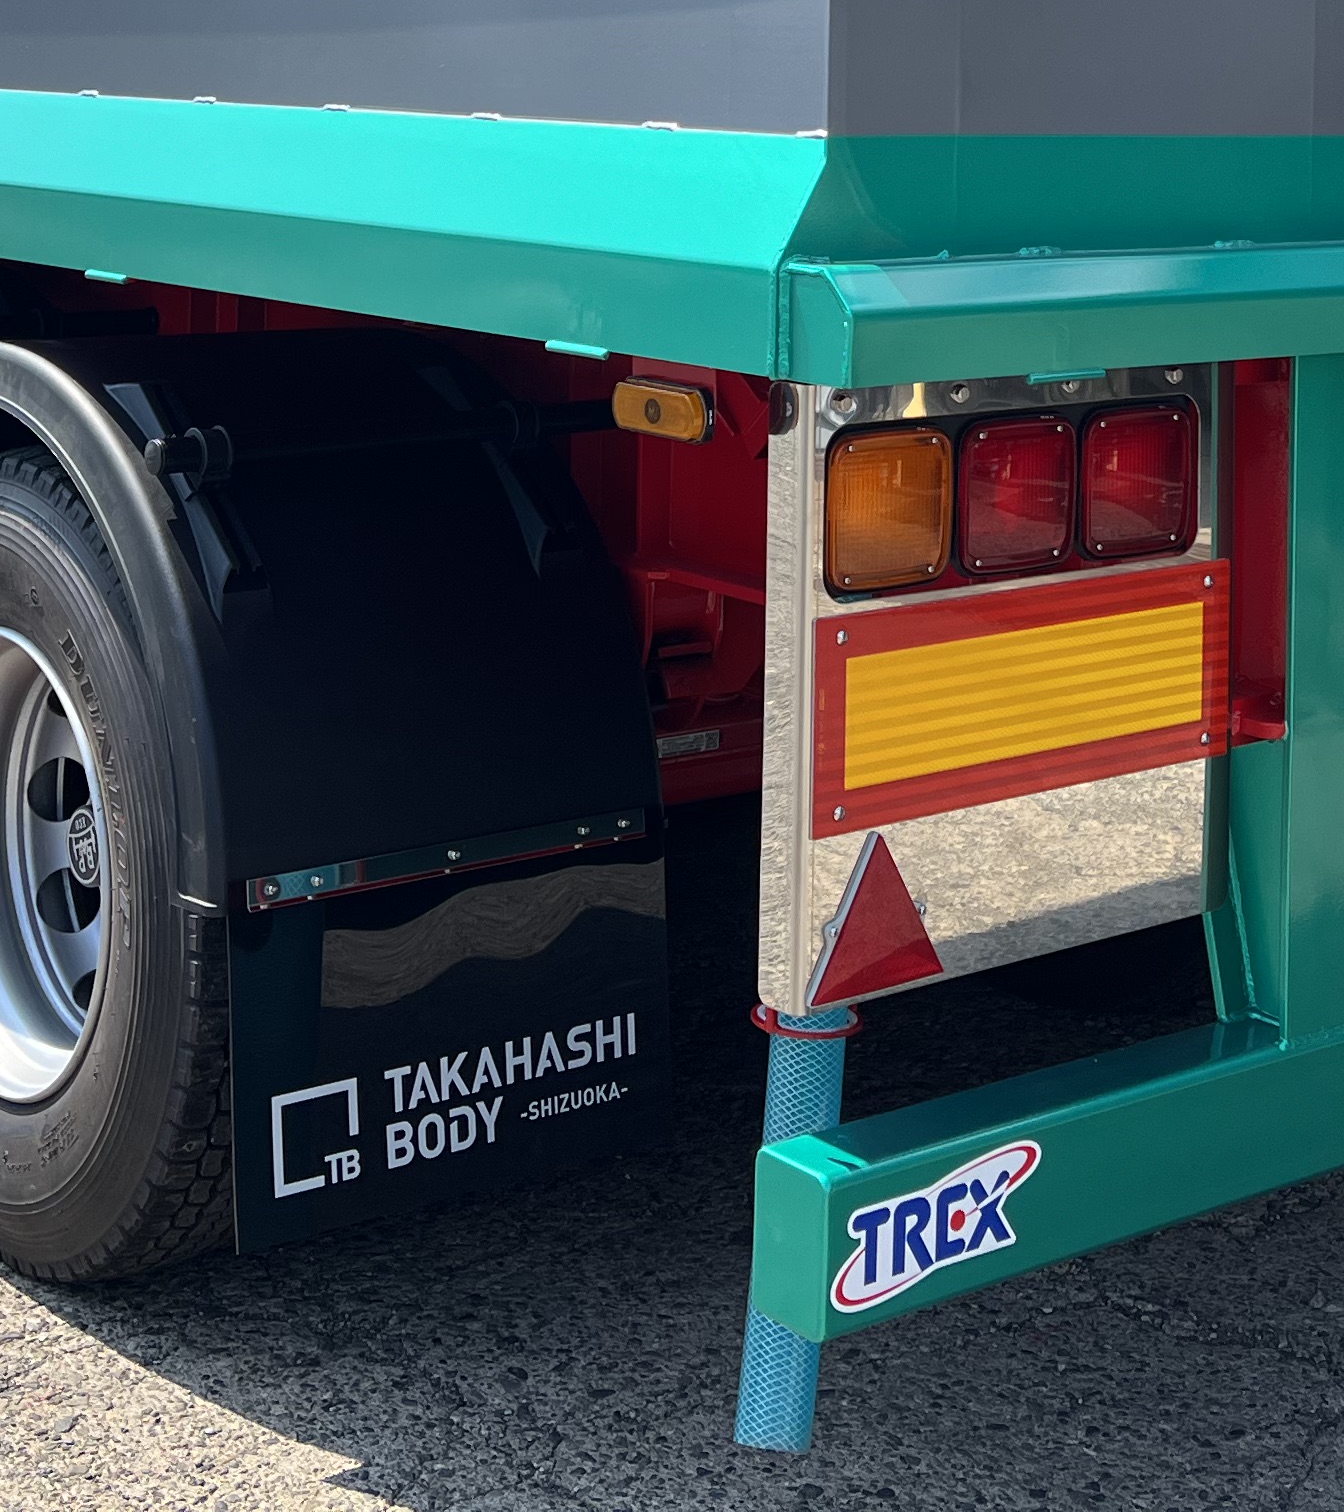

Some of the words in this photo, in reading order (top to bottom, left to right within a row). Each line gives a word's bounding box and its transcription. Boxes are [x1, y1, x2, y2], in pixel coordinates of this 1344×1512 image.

[384, 1012, 637, 1113] TAKAHASHI
[324, 1149, 361, 1184] TB
[385, 1095, 504, 1170] BODY
[852, 1170, 1011, 1286] TREX
